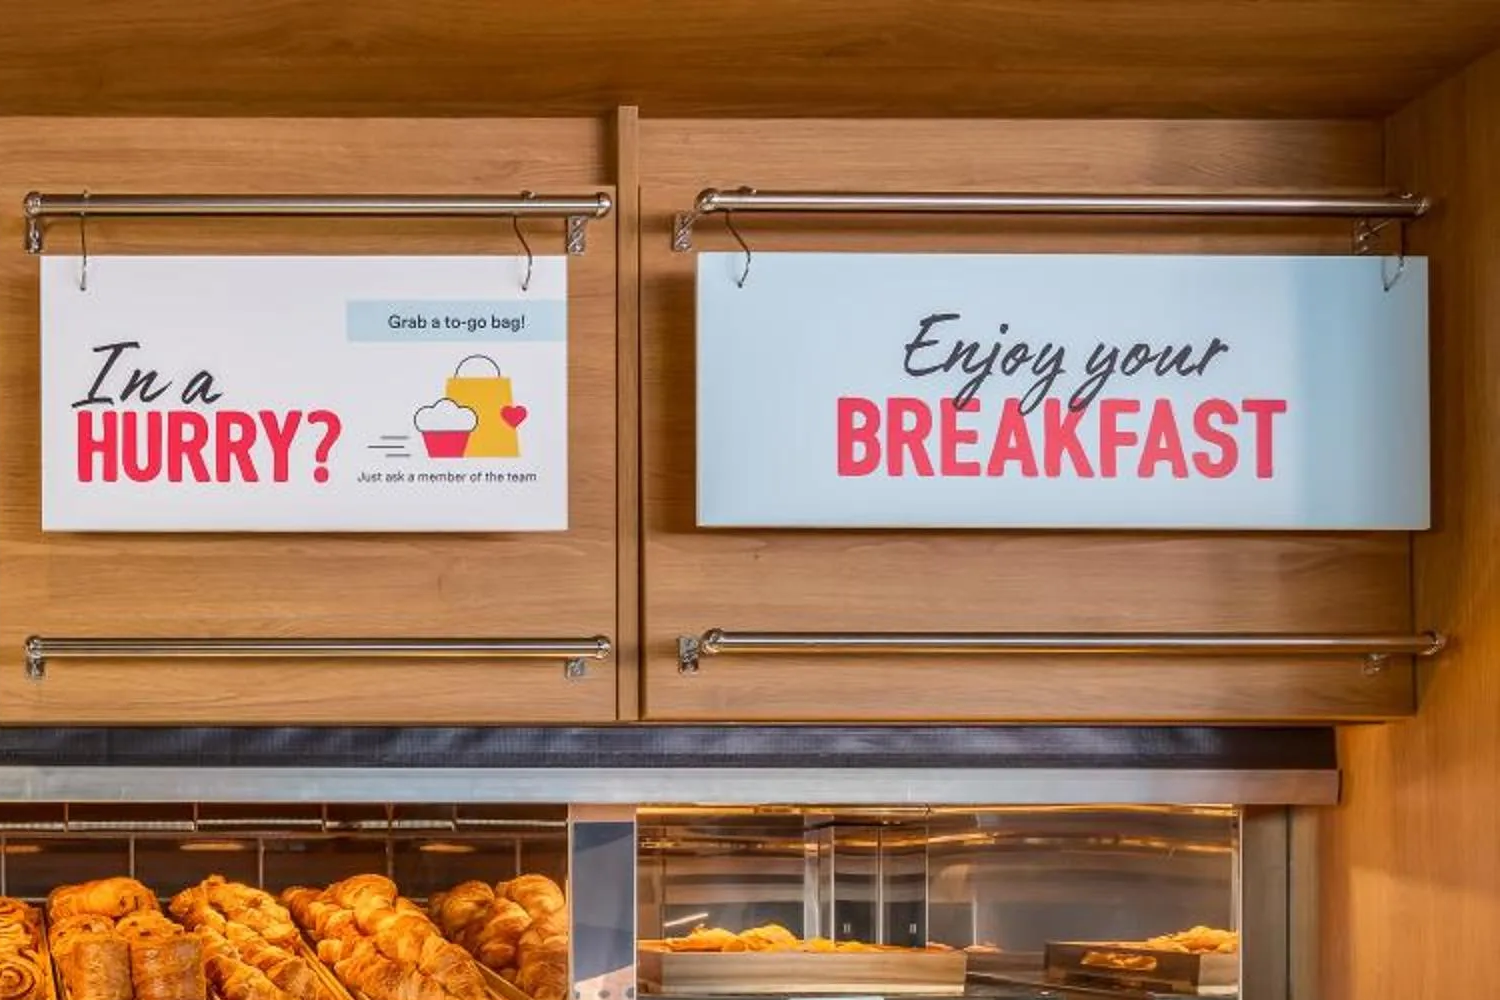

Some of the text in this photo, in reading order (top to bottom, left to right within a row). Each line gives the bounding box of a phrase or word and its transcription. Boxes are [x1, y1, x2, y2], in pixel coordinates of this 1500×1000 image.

[388, 314, 525, 333] Grab a to-go bag!
[71, 341, 223, 409] In a
[905, 313, 1228, 415] Enjoy your
[77, 409, 342, 483] HURRY?
[837, 397, 1287, 478] BREAKFAST
[357, 471, 537, 483] Just ask a member of the team
